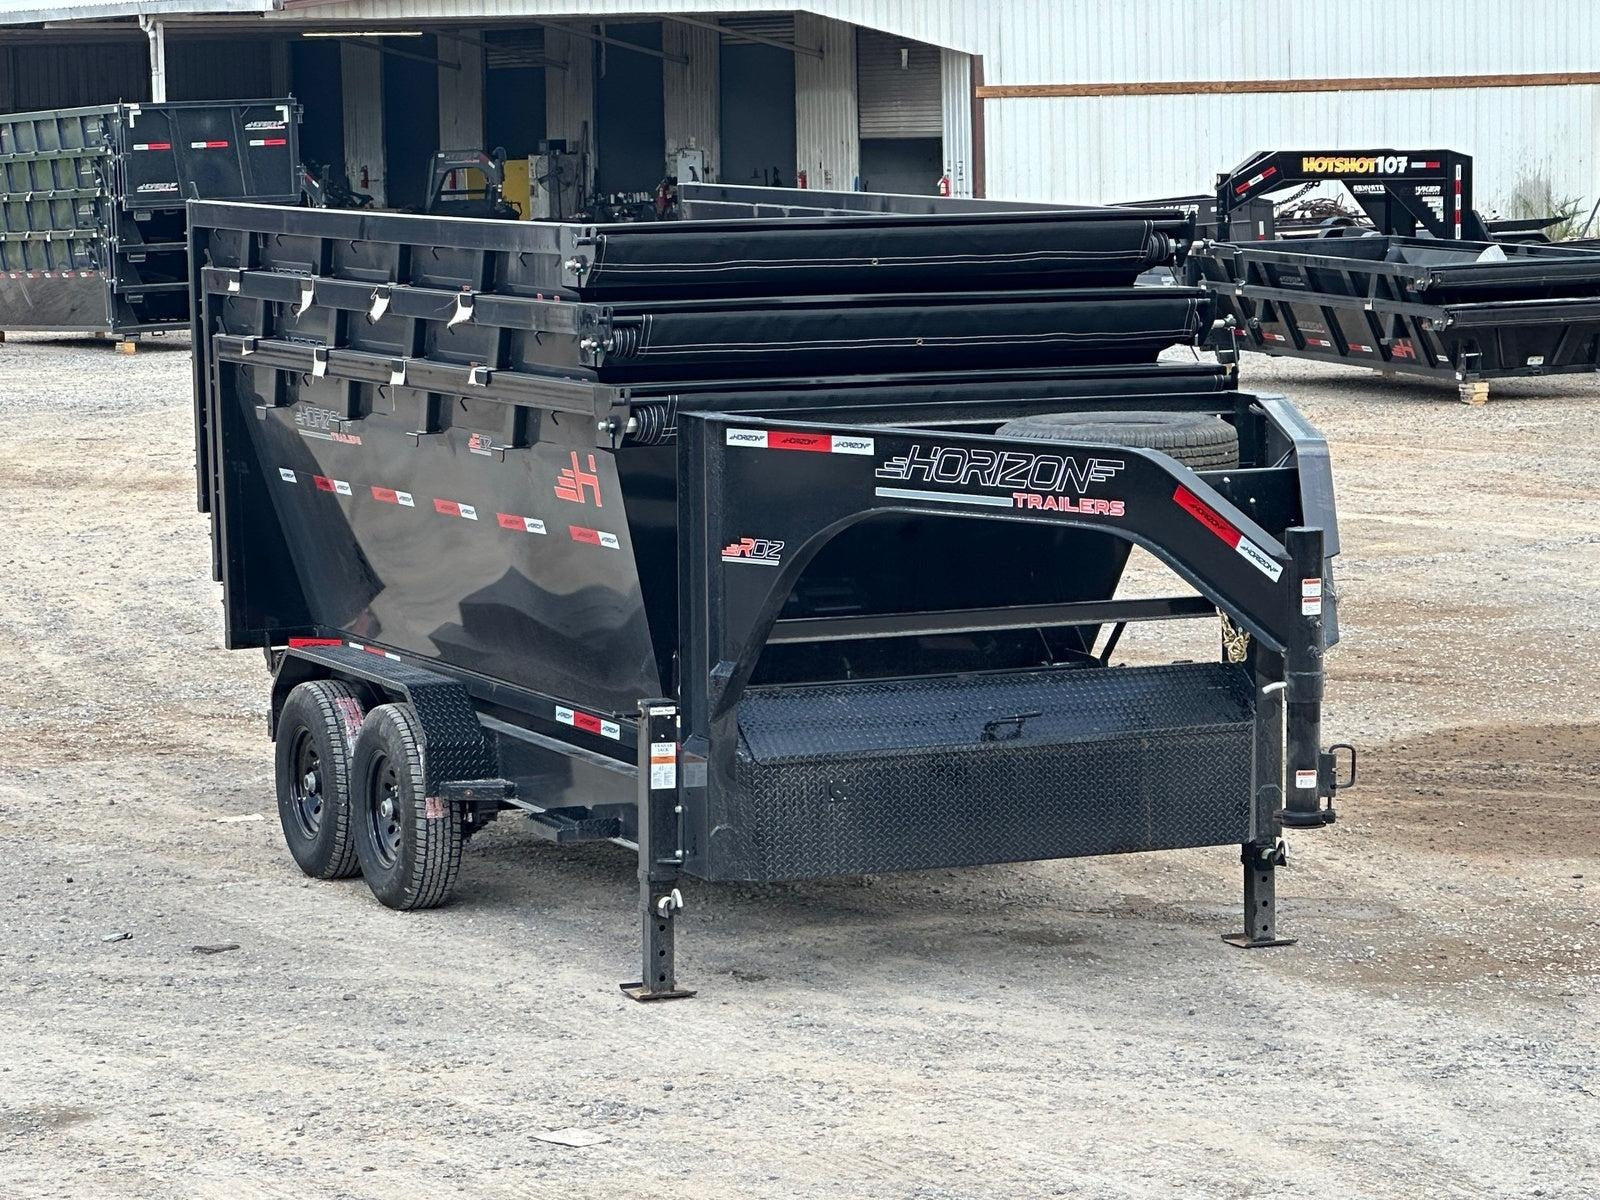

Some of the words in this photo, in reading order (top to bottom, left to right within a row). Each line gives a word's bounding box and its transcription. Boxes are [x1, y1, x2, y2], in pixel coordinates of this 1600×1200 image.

[1302, 156, 1409, 174] HOTSHOT107
[729, 434, 765, 442] HORIZON
[781, 437, 819, 445] HORIZON
[834, 441, 871, 449] HORIZON
[876, 445, 1124, 493] HORIZON
[1012, 493, 1125, 516] TRAILERS
[1240, 544, 1279, 573] HORIZON
